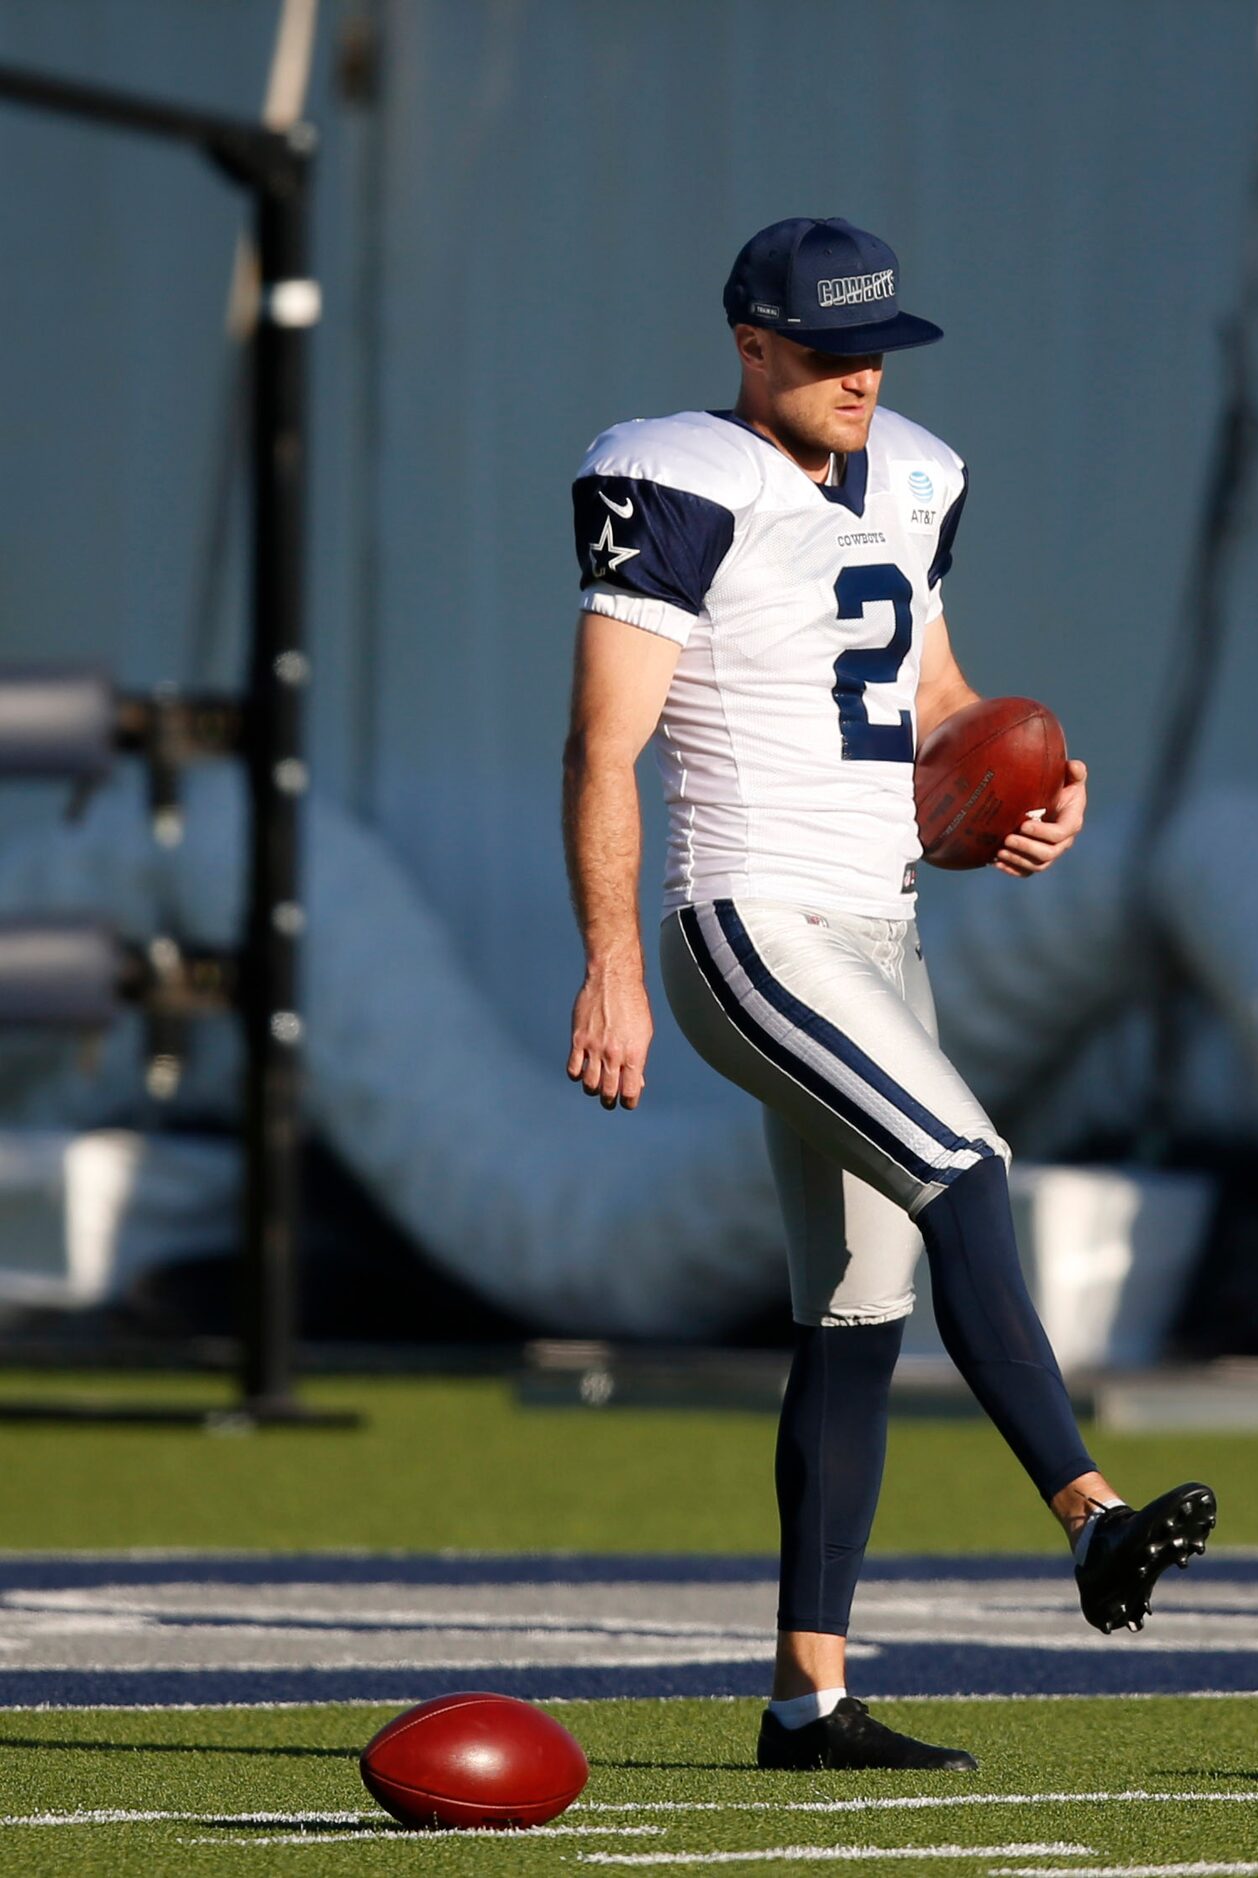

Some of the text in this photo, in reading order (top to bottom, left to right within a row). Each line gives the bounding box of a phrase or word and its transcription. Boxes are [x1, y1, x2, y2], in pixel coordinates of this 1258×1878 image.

[818, 269, 895, 307] COWBOYS
[911, 509, 936, 525] AT&T
[837, 532, 886, 547] COWBOYS
[832, 563, 914, 762] 2
